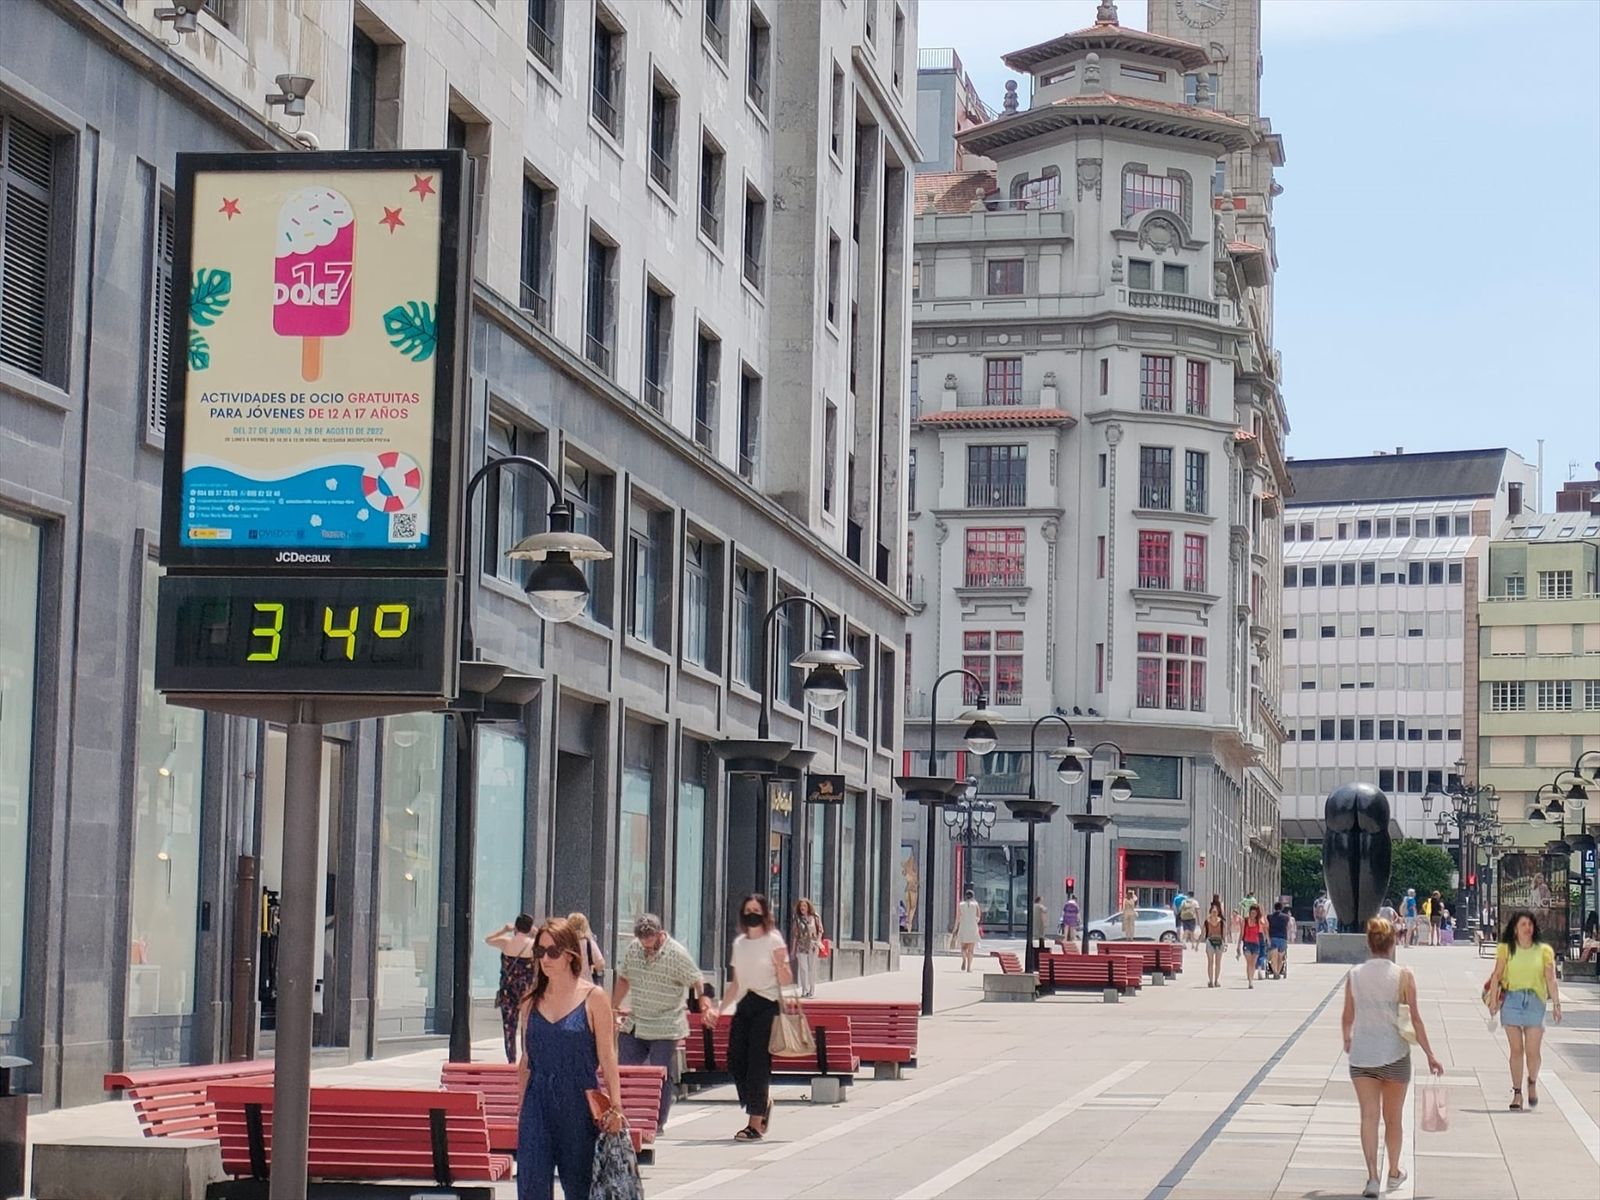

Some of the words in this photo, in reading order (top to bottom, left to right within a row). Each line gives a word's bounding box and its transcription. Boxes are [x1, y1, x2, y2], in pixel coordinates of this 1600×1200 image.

[274, 282, 340, 306] DOCE
[200, 392, 286, 404] ACTIVIDADES
[290, 392, 306, 404] DE
[309, 392, 344, 404] OCIO
[347, 391, 420, 404] GRATUITAS
[210, 408, 242, 419] PARA
[246, 404, 305, 419] JÓVENES
[308, 408, 324, 419] DE
[328, 408, 339, 419] 12
[342, 408, 351, 419] A
[355, 408, 366, 419] 17
[370, 405, 409, 419] AÑOS
[233, 426, 246, 435] DEL
[258, 426, 267, 435] DE
[270, 426, 292, 435] JUNIO
[294, 426, 302, 435] AL
[314, 427, 323, 435] DE
[326, 427, 354, 435] AGOSTO
[356, 427, 364, 435] DE
[366, 427, 384, 435] 2022
[275, 551, 331, 563] JCDecaux
